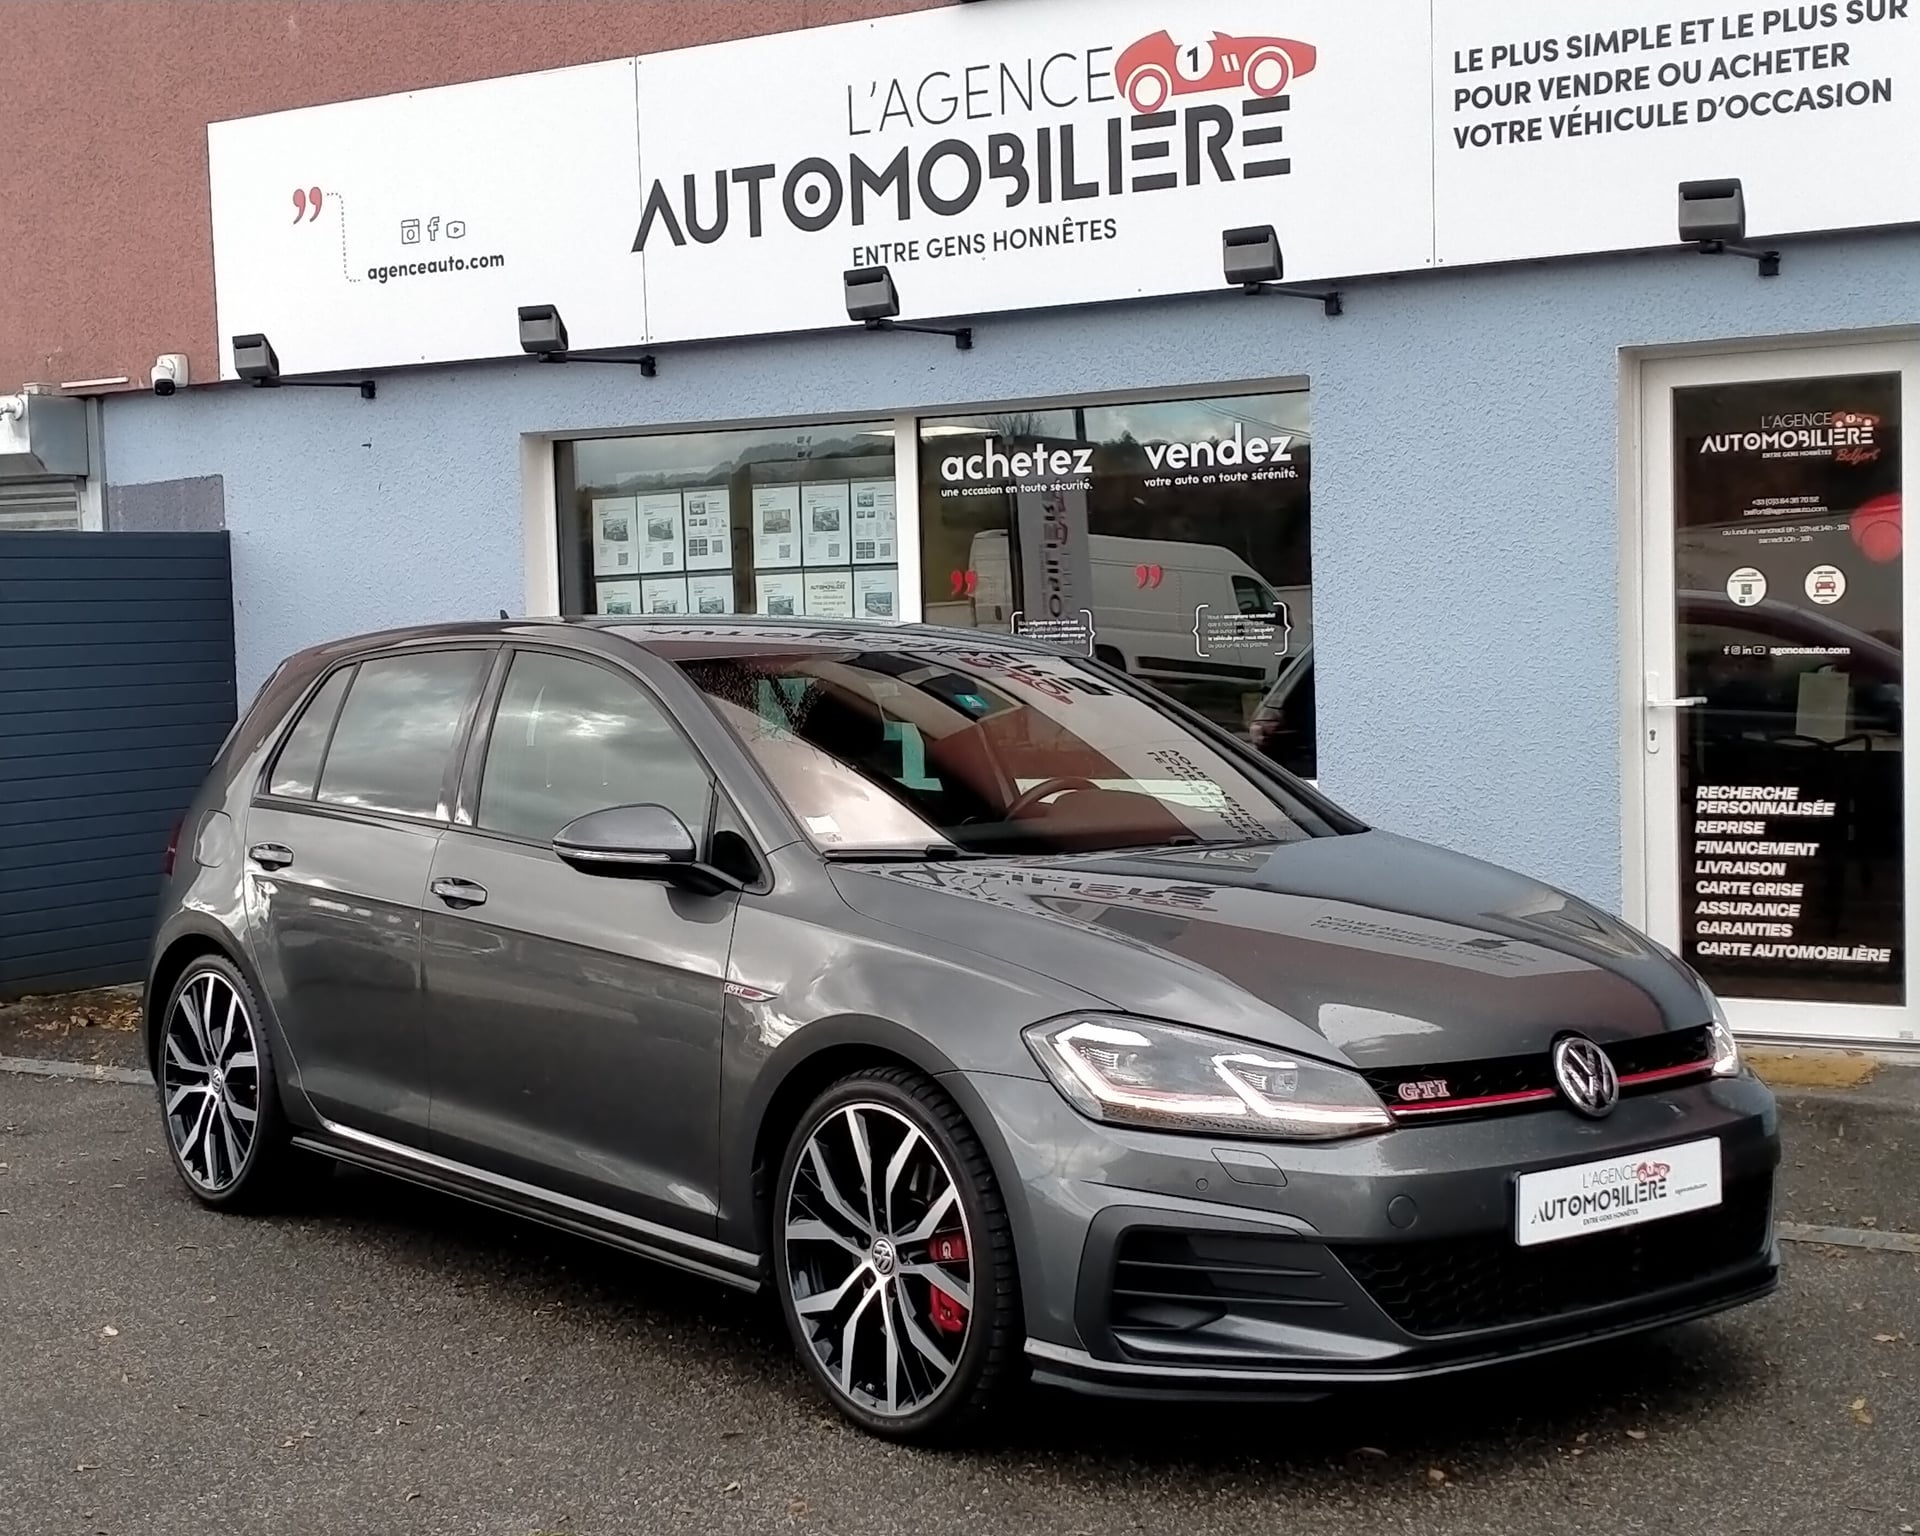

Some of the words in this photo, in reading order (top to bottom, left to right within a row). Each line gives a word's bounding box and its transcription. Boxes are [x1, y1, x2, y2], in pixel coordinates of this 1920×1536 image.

[1455, 48, 1483, 73] LE
[1492, 39, 1559, 69] PLUS
[1566, 24, 1672, 59] SIMPLE
[1681, 18, 1715, 45] ET
[1722, 14, 1754, 40] LE
[1763, 3, 1838, 35] PLUS
[1846, 0, 1908, 24] SUR
[1454, 81, 1531, 112] POUR
[1538, 66, 1650, 101] VENDRE
[1658, 60, 1702, 87] OU
[1708, 43, 1850, 82] ACHETER
[848, 47, 1115, 135] L'AGENCE
[1454, 118, 1543, 149] VOTRE
[1549, 101, 1688, 138] VÉHICULE
[1697, 78, 1892, 123] D'OCCASION
[853, 241, 920, 267] ENTRE
[926, 231, 986, 259] GENS
[993, 217, 1117, 252] HONNÊTES
[367, 254, 505, 284] agenceauto.com
[1143, 422, 1292, 470] vendez
[941, 438, 1094, 481] achetez
[941, 488, 959, 497] une
[961, 484, 1003, 496] occasion
[1005, 484, 1018, 494] en
[1020, 482, 1048, 493] toute
[1050, 478, 1093, 492] sécurité.
[1144, 476, 1171, 488] votre
[1174, 473, 1200, 485] auto
[1202, 475, 1216, 484] en
[1218, 471, 1248, 482] toute
[1251, 466, 1299, 481] sérénité.
[1769, 645, 1850, 656] agenceauto.com
[1696, 785, 1800, 800] RECHERCHE
[1696, 799, 1836, 816] PERSONNALISÉE
[1695, 820, 1766, 835] REPRISE
[1695, 841, 1819, 856] FINANCEMENT
[1695, 860, 1787, 876] LIVRAISON
[1696, 880, 1752, 896] CARTE
[1752, 882, 1804, 897] GRISE
[1695, 901, 1801, 917] ASSURANCE
[1696, 921, 1793, 937] GARANTIES
[1696, 941, 1752, 957] CARTE
[1751, 943, 1891, 962] AUTOMOBILIÈRE
[1397, 1079, 1451, 1101] GTI
